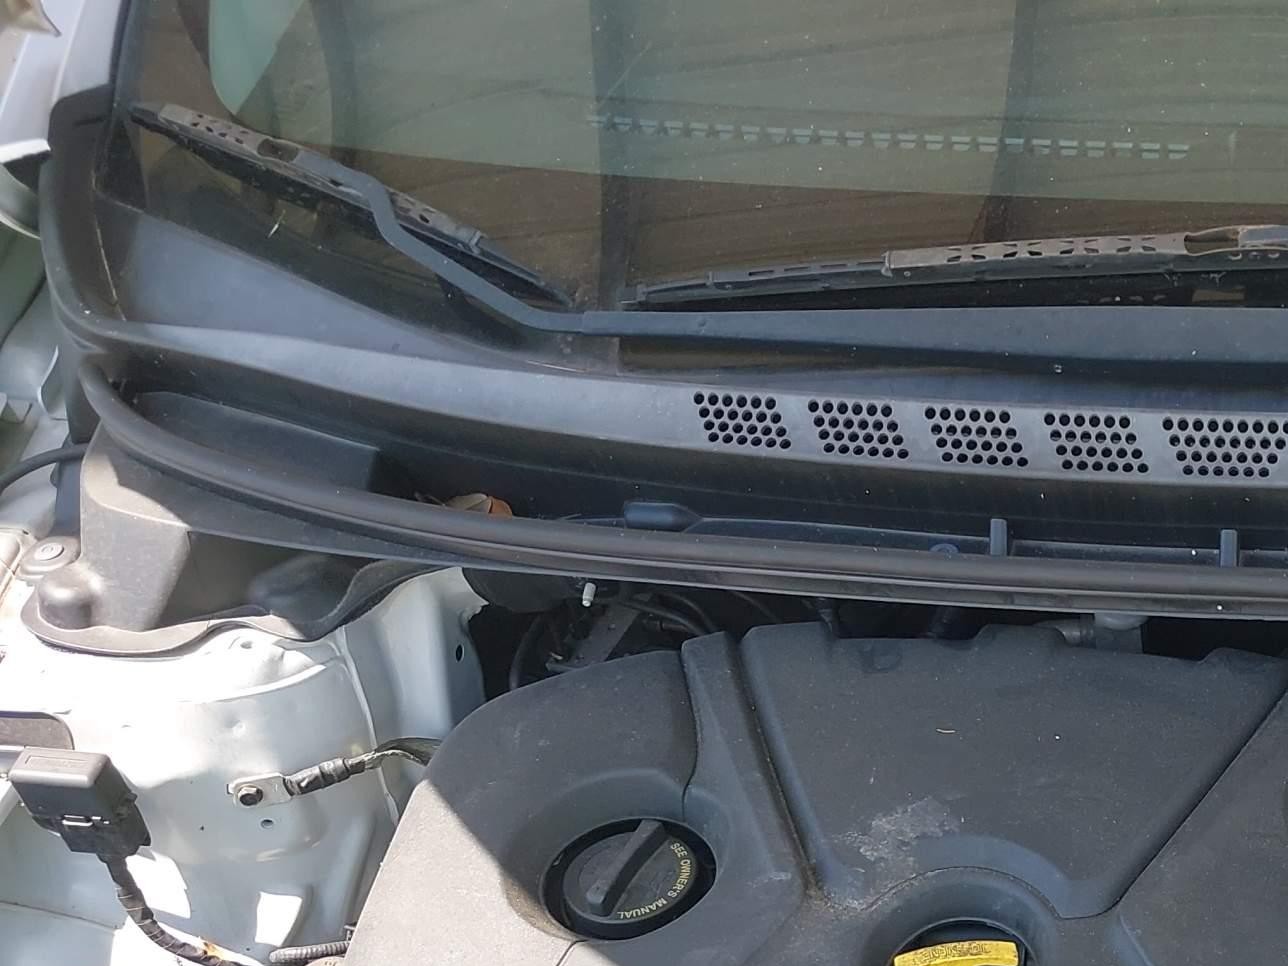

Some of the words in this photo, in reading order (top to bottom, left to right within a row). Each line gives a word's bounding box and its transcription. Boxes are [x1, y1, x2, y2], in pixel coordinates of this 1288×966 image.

[669, 842, 689, 858] SEE
[667, 858, 692, 899] OWNER'S
[617, 896, 669, 920] MANUAL
